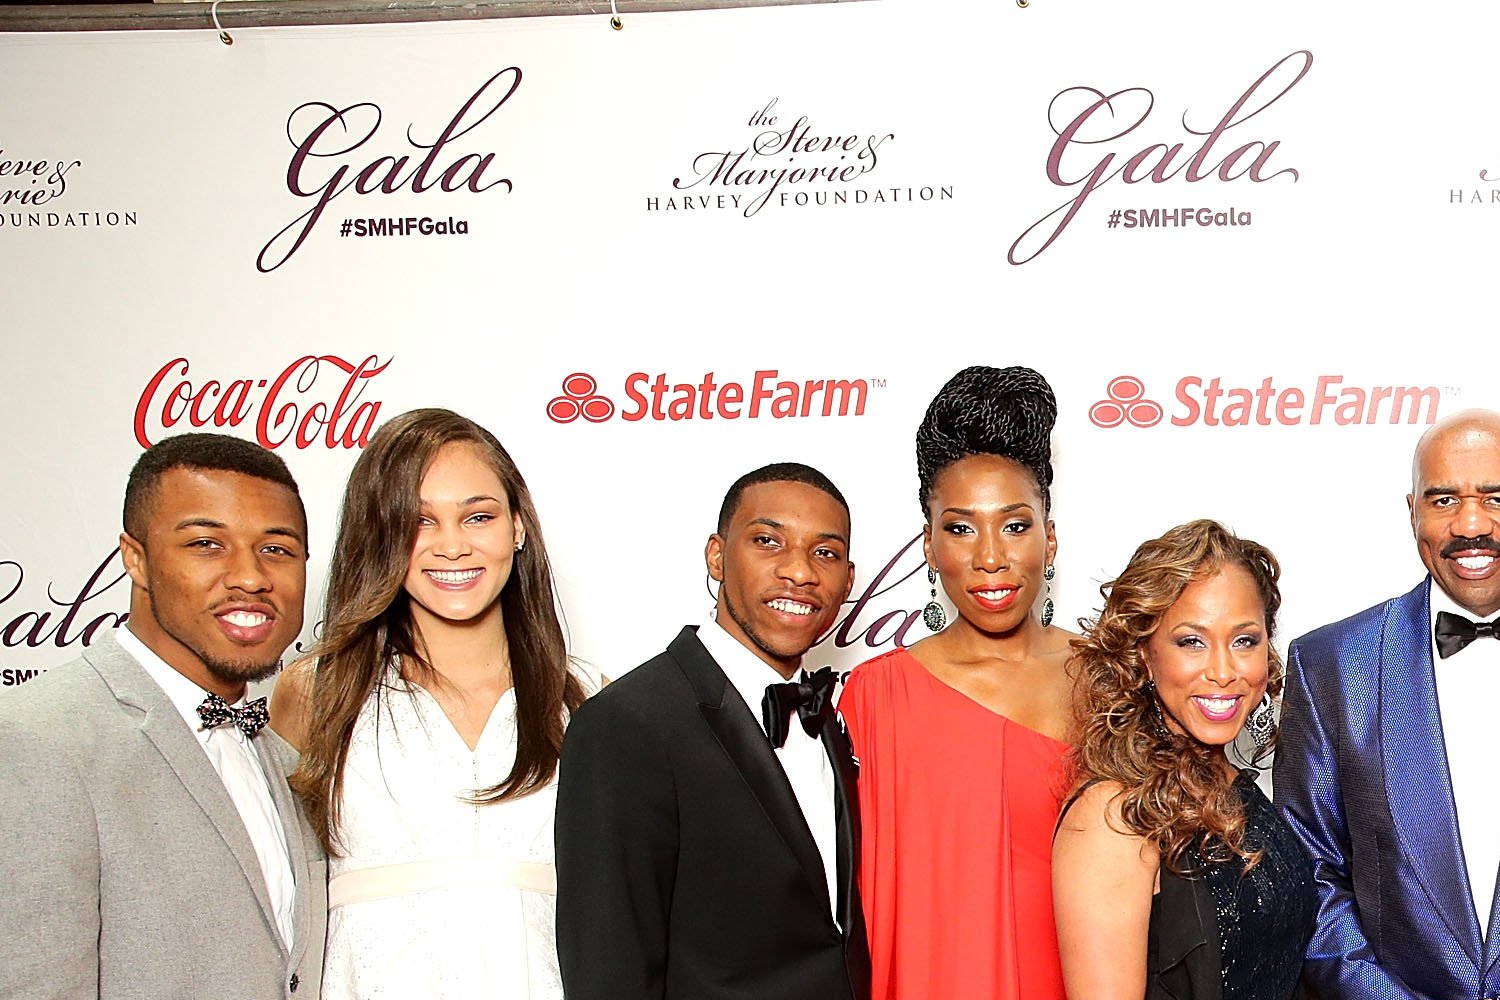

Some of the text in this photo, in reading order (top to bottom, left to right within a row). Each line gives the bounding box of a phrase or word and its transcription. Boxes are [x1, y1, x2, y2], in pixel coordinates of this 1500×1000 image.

[748, 96, 779, 127] the
[750, 115, 860, 161] Steve
[256, 66, 523, 273] Gala
[1006, 50, 1313, 266] Gala
[646, 185, 954, 212] HARVEY FOUNDATION
[672, 147, 865, 218] Marjorie
[0, 211, 138, 228] UNDATION
[340, 215, 469, 238] #SMHFGala
[1107, 207, 1252, 229] #SMHFGala
[134, 354, 396, 450] Coca-Cola
